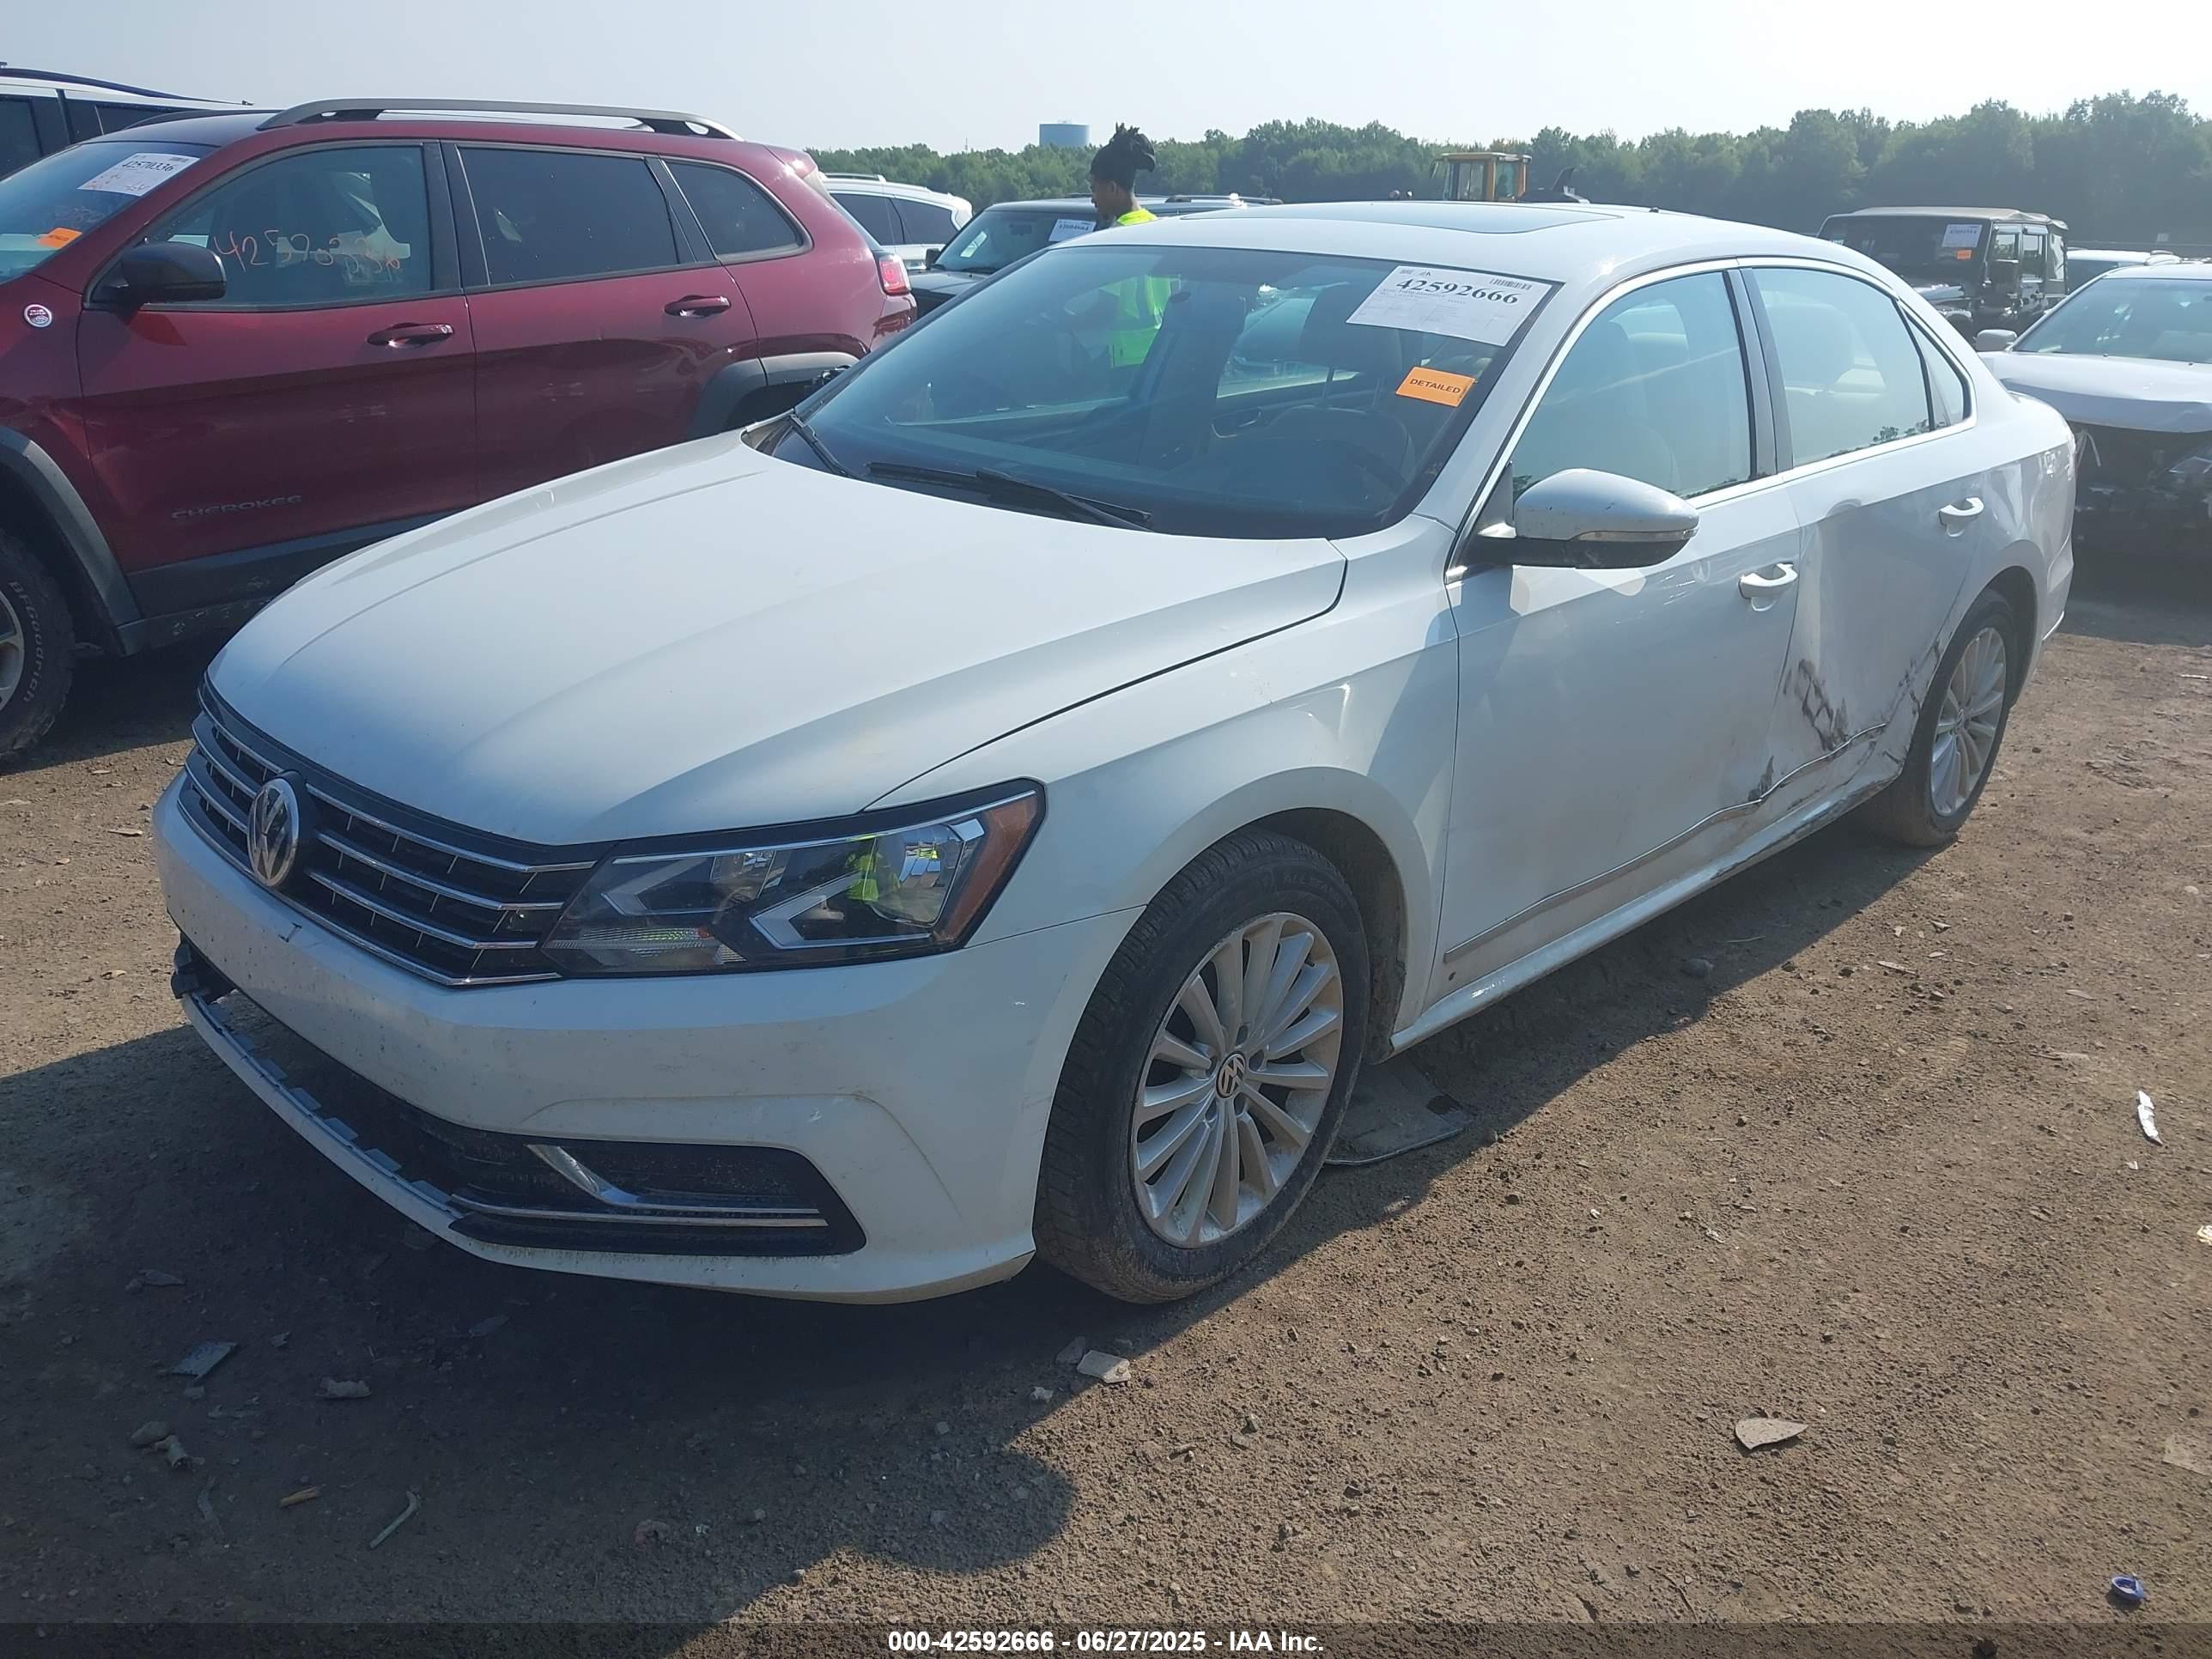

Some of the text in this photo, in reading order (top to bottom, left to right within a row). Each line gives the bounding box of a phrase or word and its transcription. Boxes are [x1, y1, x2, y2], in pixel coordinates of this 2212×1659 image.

[1395, 278, 1522, 305] 42592666
[1409, 378, 1461, 394] DETAILED
[172, 495, 302, 519] CHEROKEE
